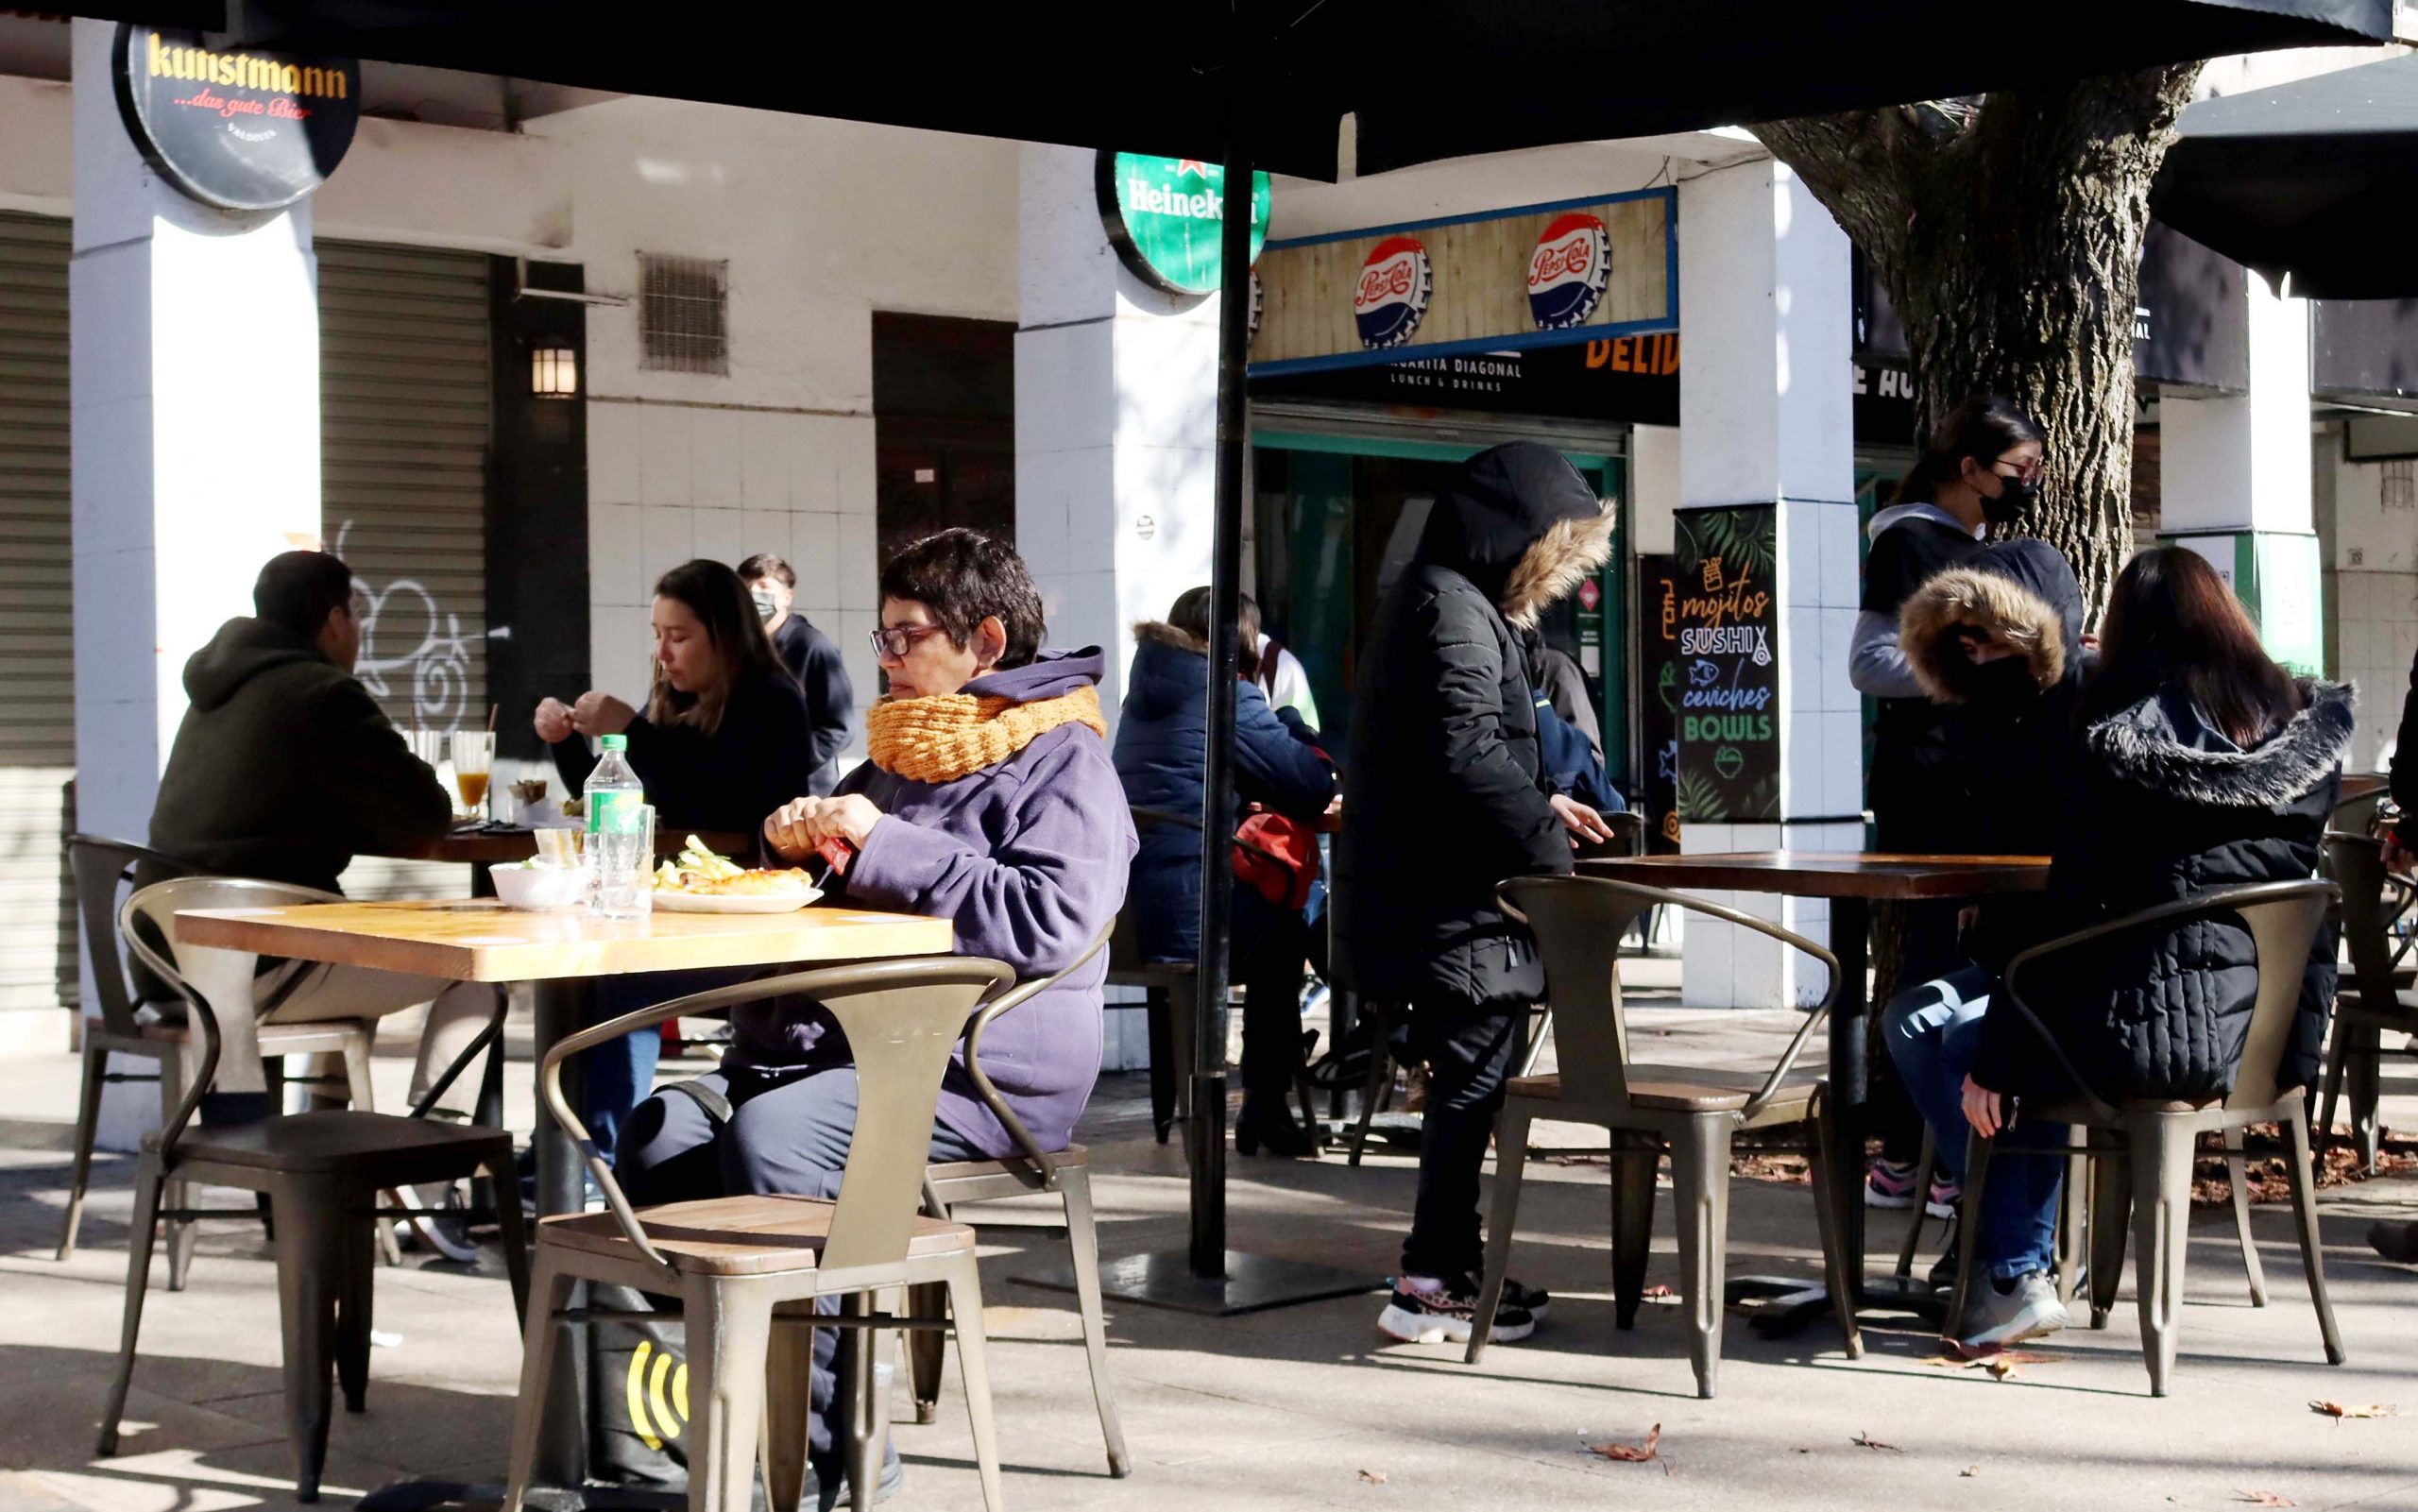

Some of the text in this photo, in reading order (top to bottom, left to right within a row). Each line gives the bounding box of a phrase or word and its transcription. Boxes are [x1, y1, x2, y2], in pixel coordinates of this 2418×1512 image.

[148, 32, 347, 99] kunstmann
[219, 99, 264, 117] gute
[267, 98, 312, 120] Bier
[1128, 178, 1258, 225] Heinek
[1455, 358, 1522, 378] DIAGONAL
[1390, 373, 1431, 386] LUNCH
[1453, 379, 1501, 392] DRINKS
[1682, 561, 1770, 650] mojitos
[1681, 626, 1753, 654] SUSHI
[1683, 657, 1771, 711] ceviches
[1684, 715, 1772, 740] BOWLS
